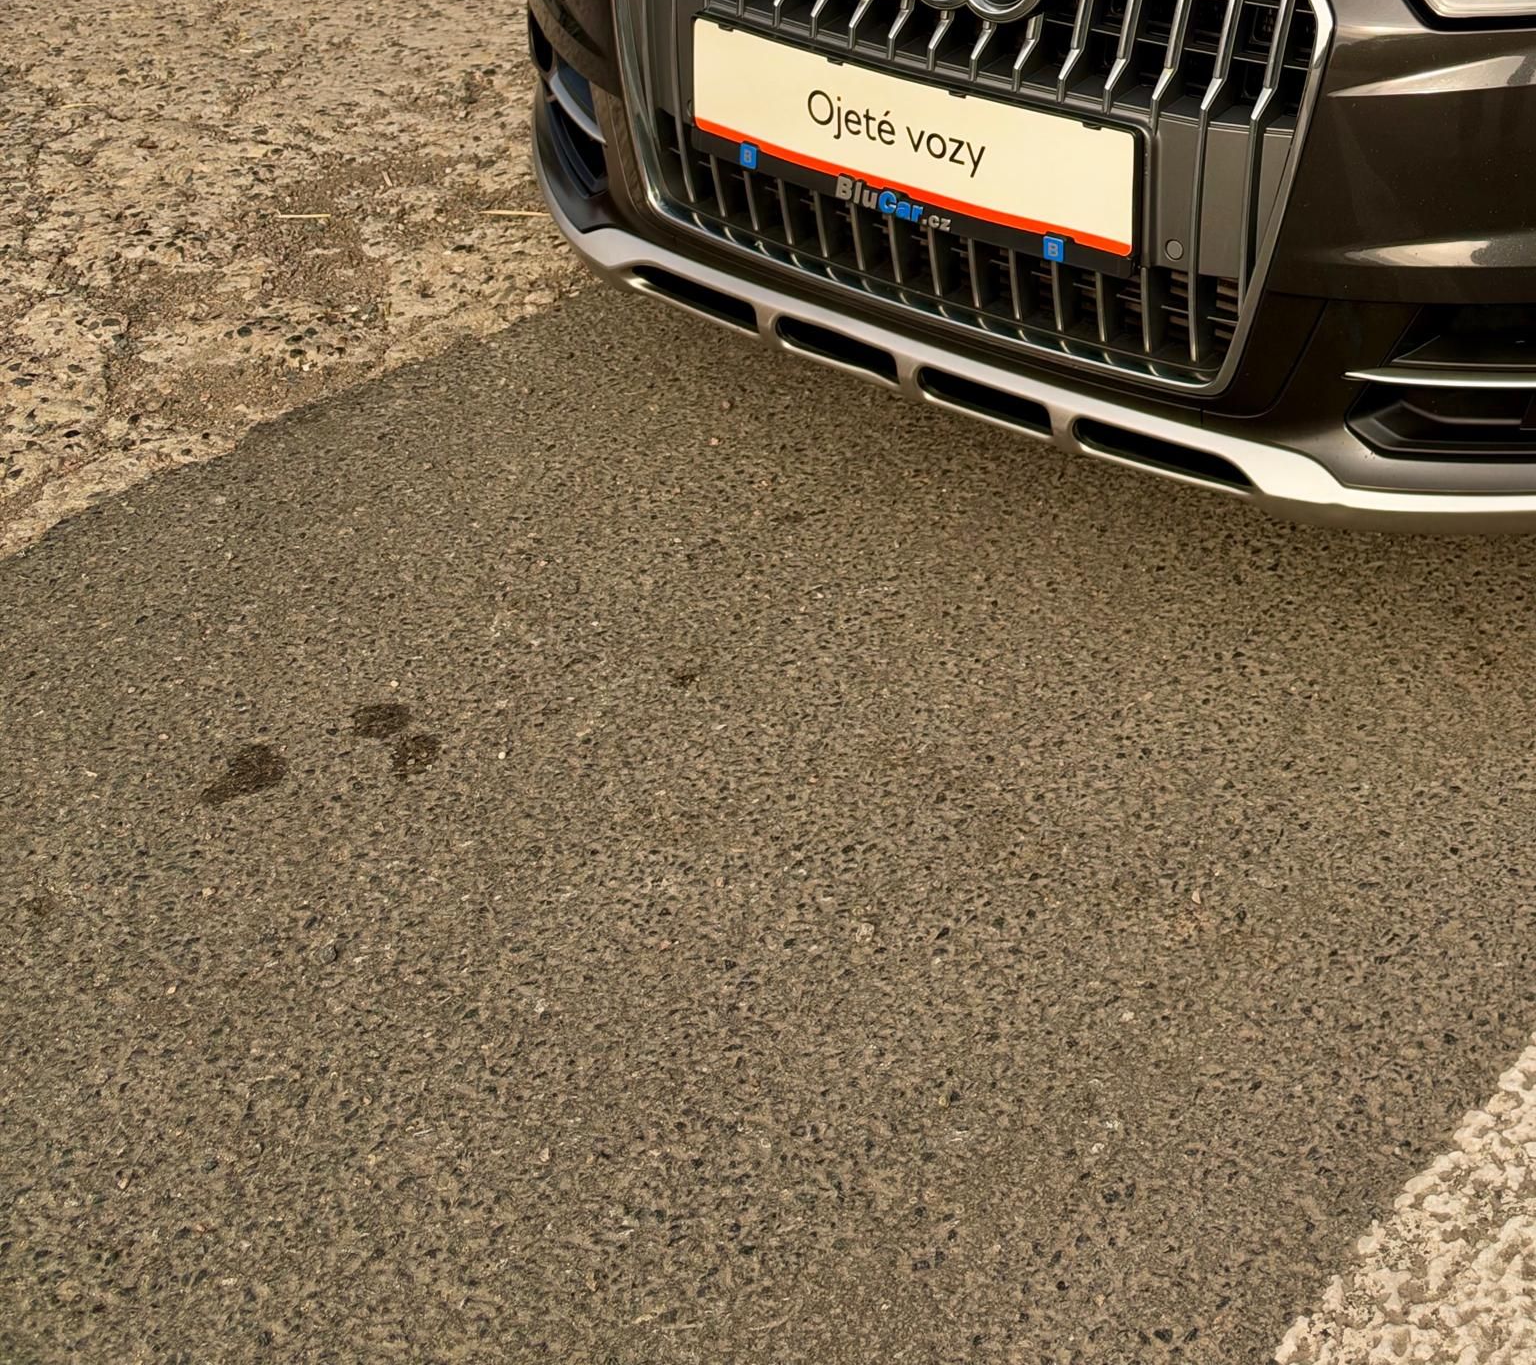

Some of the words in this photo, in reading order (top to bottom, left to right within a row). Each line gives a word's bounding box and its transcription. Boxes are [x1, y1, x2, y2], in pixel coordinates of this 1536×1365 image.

[807, 89, 895, 145] Ojeté
[906, 126, 985, 178] vozy
[836, 175, 951, 231] BluCar.cz
